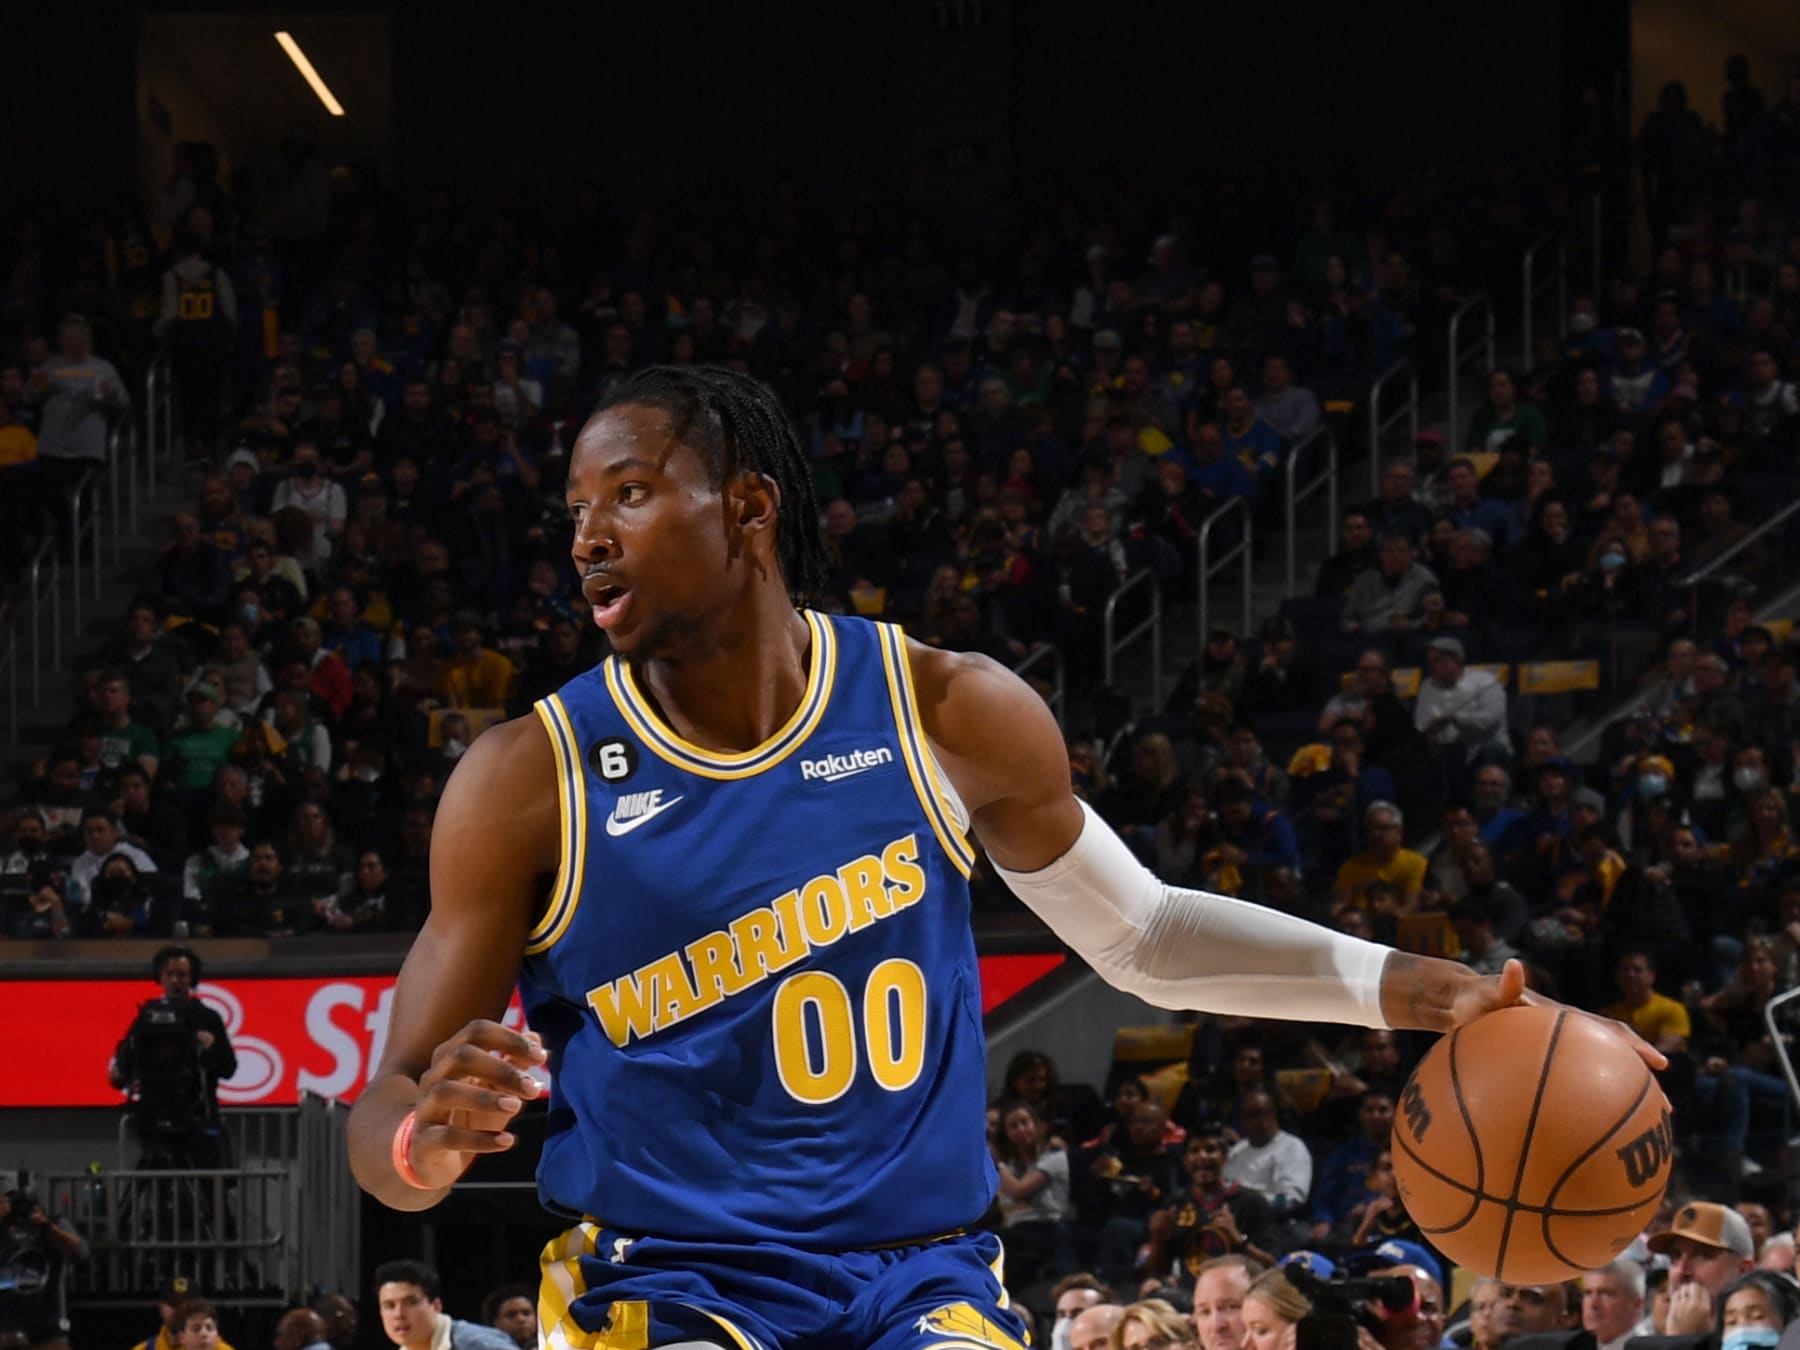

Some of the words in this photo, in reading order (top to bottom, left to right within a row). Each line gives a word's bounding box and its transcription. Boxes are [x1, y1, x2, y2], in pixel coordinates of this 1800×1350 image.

[599, 743, 629, 779] 6
[800, 745, 893, 782] Rakuten
[614, 788, 664, 820] NIKE
[586, 833, 927, 1048] WARRIORS
[772, 957, 928, 1105] 00
